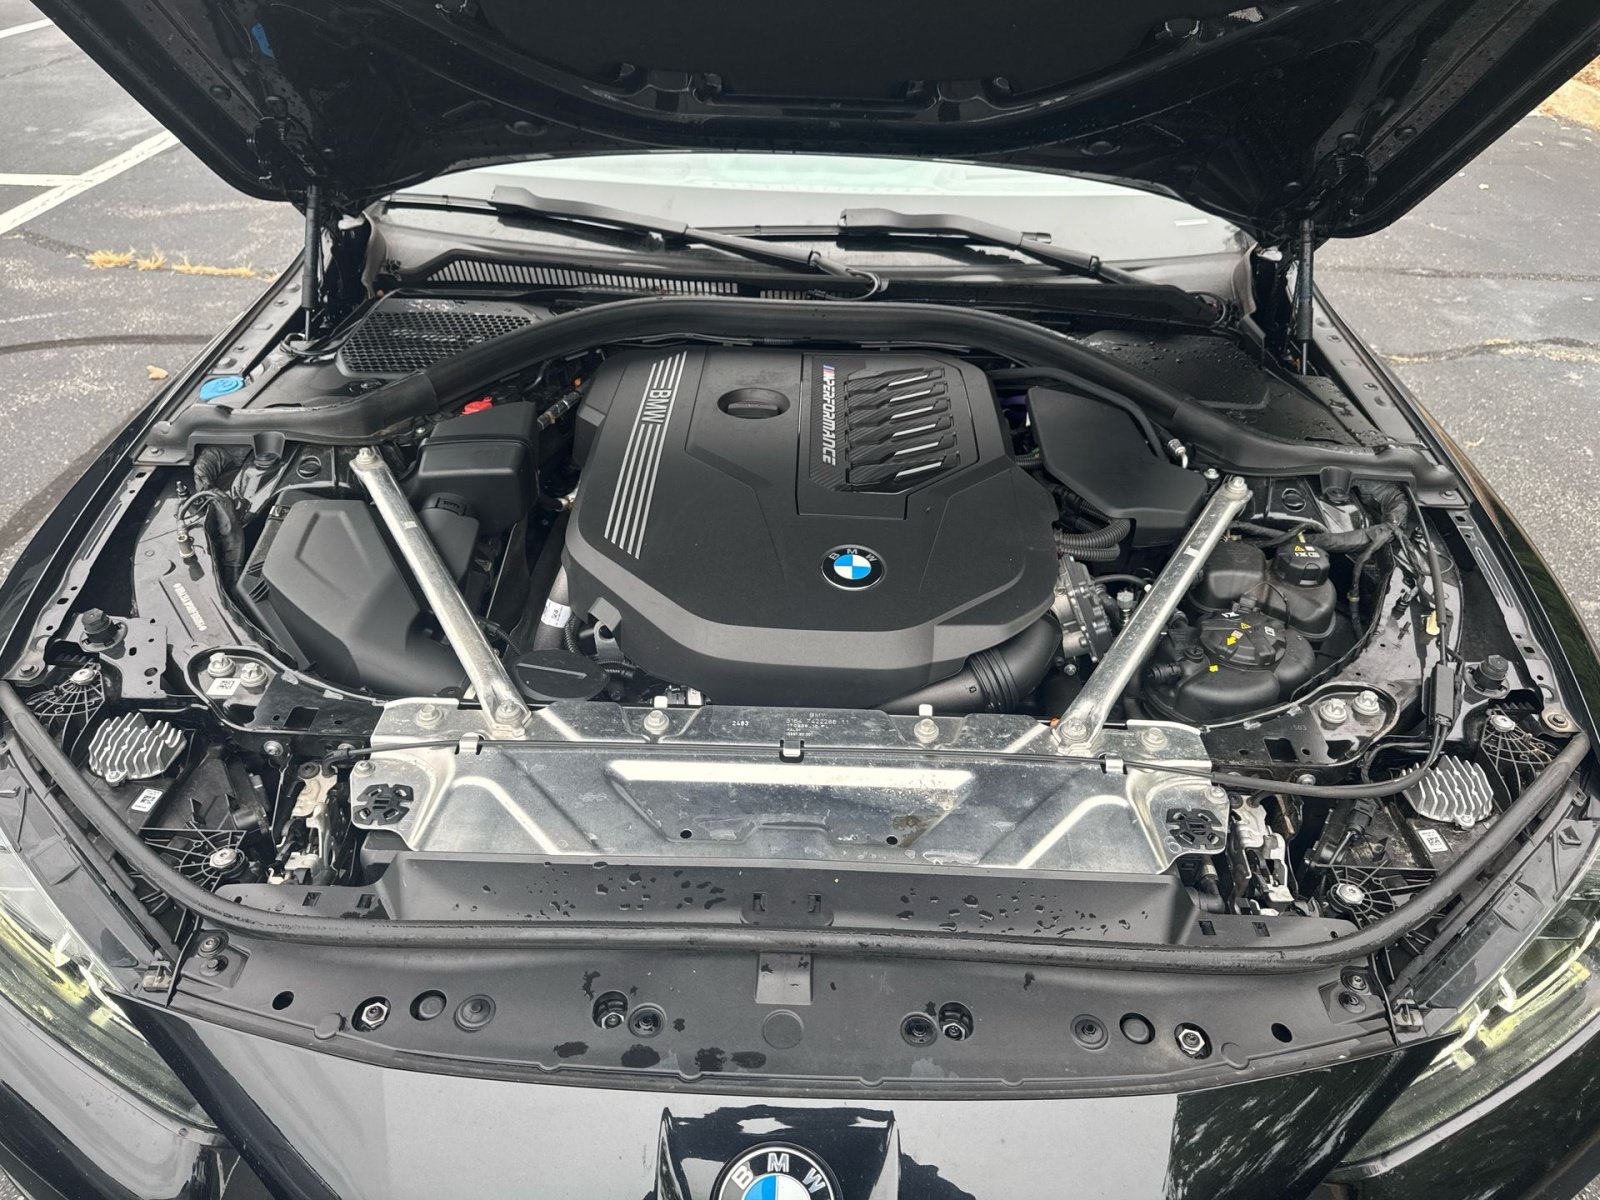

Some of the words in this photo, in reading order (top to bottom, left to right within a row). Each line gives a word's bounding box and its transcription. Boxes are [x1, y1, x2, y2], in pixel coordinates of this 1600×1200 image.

[641, 389, 672, 423] BMW
[822, 377, 836, 467] PERFORMANCE
[828, 548, 878, 562] BMW
[731, 1152, 826, 1194] BMW
